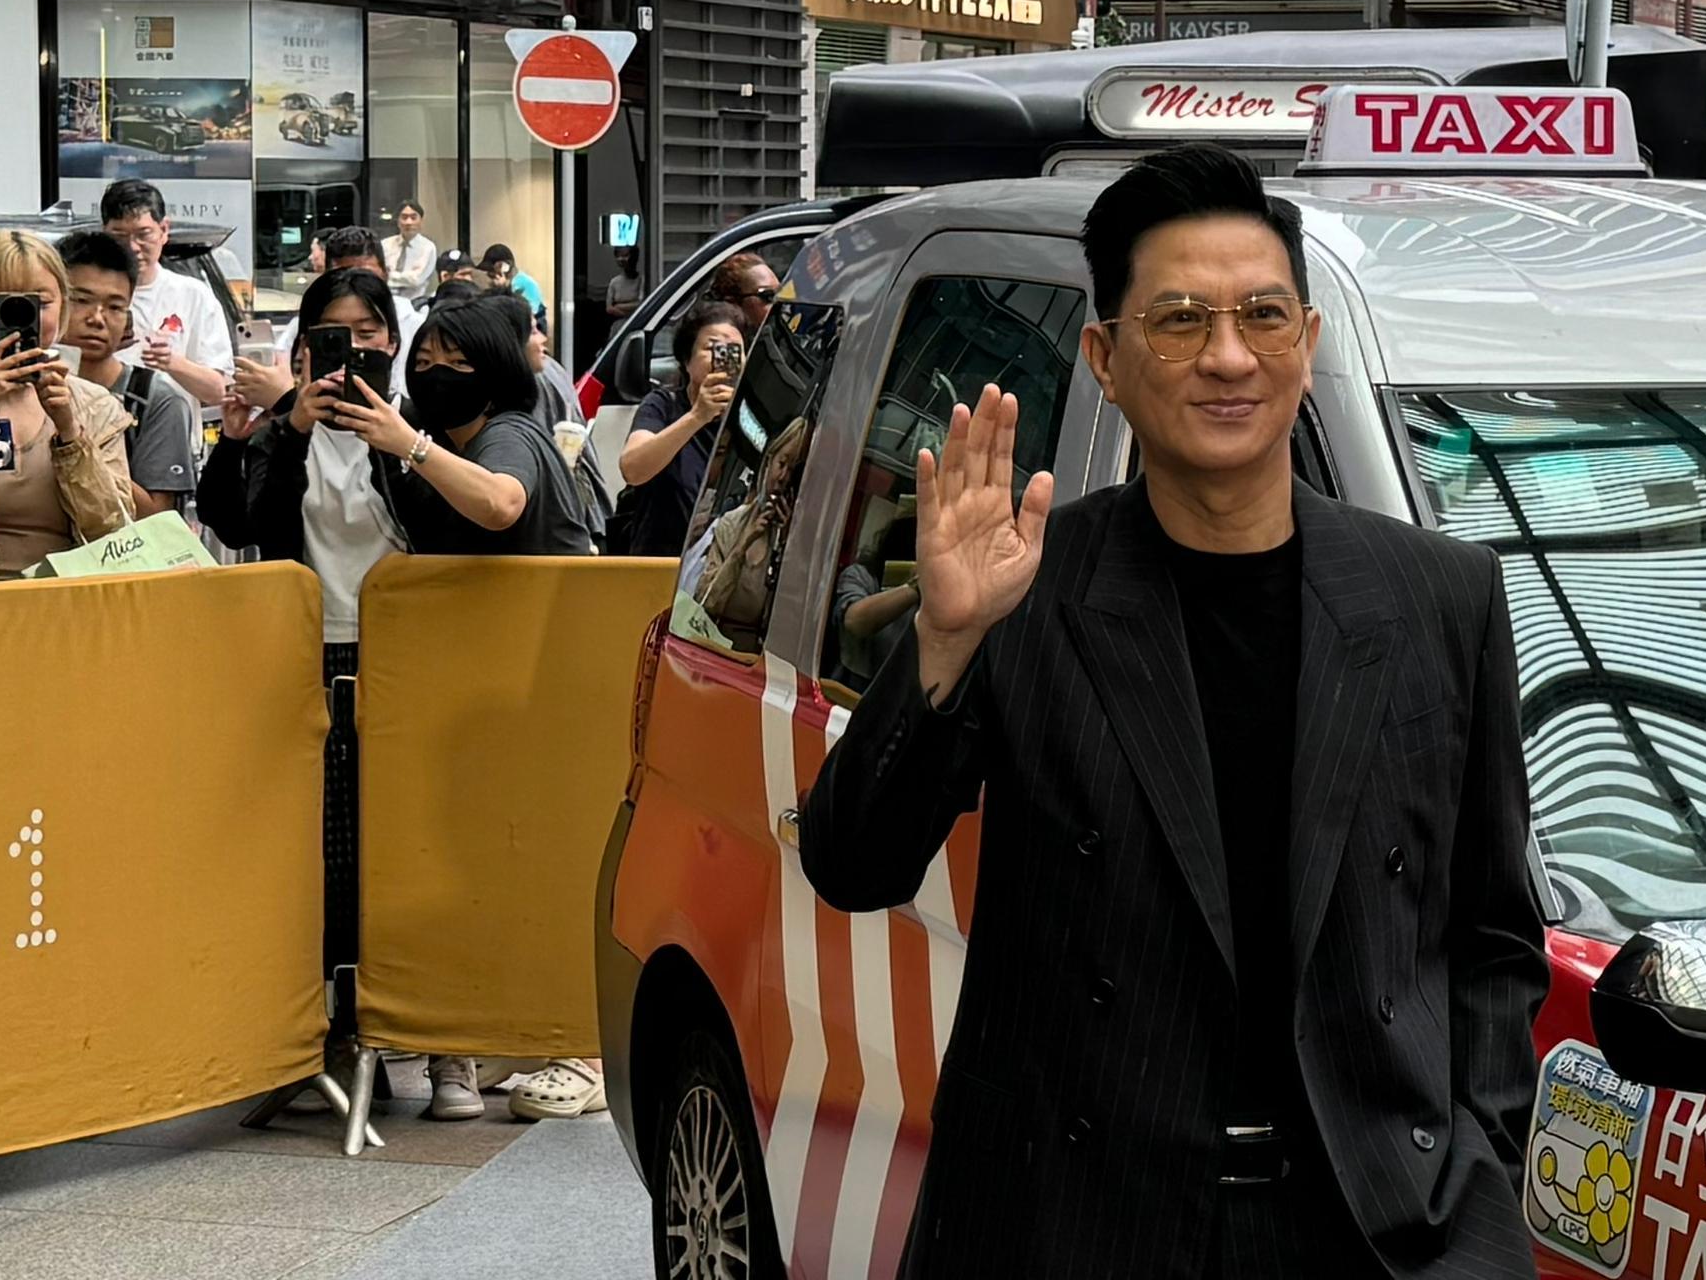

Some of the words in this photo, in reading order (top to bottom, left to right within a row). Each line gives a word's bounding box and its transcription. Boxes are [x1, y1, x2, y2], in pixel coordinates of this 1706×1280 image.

[1169, 21, 1250, 39] KAYSER
[1141, 83, 1274, 118] Mister
[1355, 94, 1615, 155] TAXI
[1562, 1219, 1587, 1240] LPG
